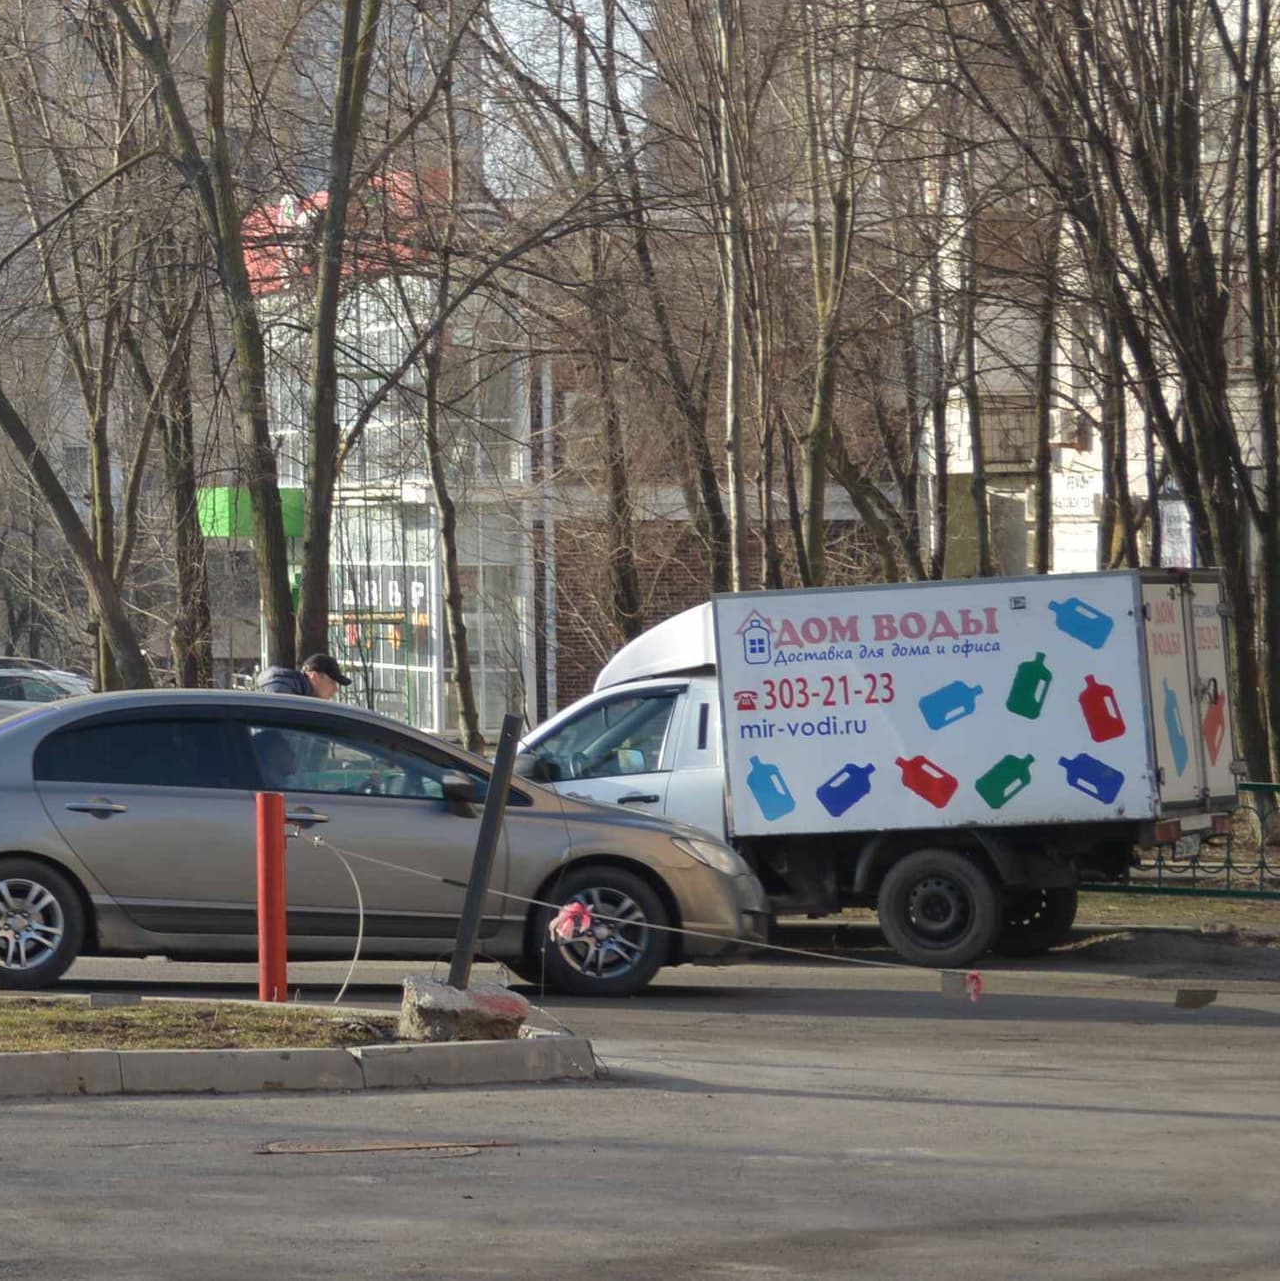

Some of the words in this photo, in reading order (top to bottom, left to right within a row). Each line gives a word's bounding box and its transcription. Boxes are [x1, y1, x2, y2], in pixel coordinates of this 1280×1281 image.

[773, 614, 861, 650] ДОМ
[873, 606, 1001, 642] ВОДЫ
[773, 643, 853, 667] Доставка
[858, 641, 885, 659] для
[891, 639, 931, 657] дома
[937, 641, 946, 655] и
[952, 636, 1001, 657] офиса
[762, 671, 896, 711] 303-21-23
[740, 715, 868, 740] mir-vodi.ru
